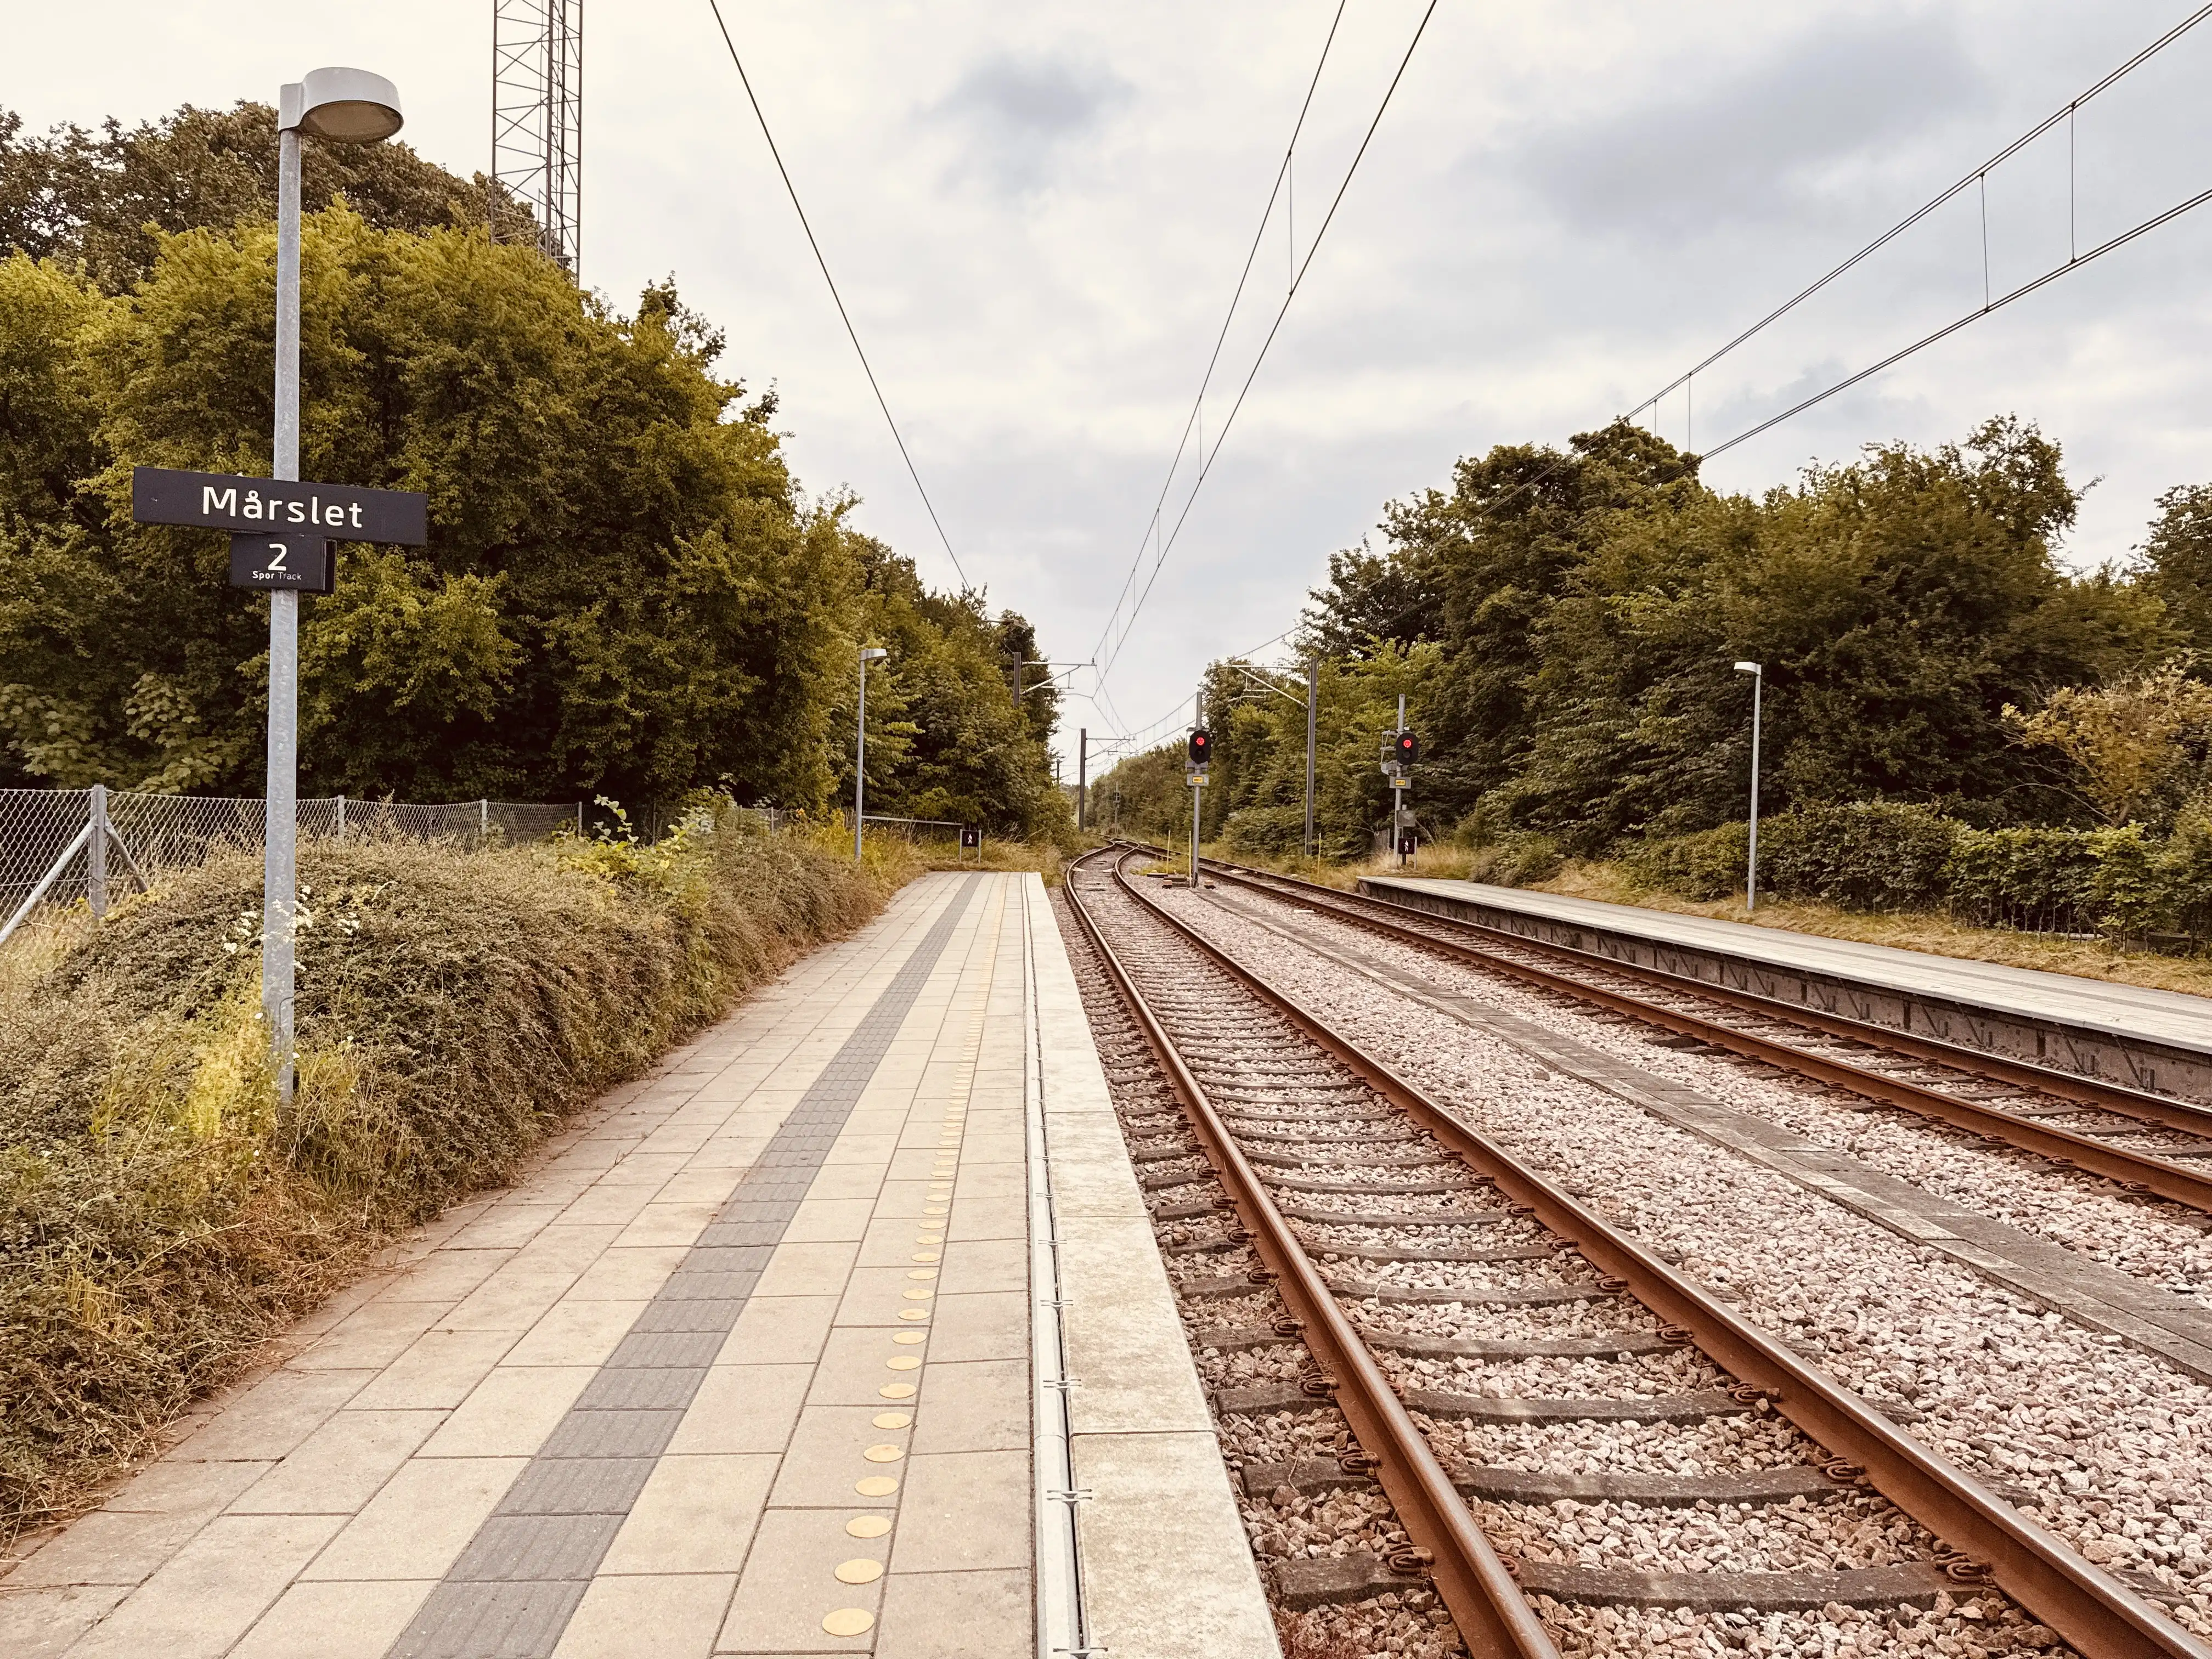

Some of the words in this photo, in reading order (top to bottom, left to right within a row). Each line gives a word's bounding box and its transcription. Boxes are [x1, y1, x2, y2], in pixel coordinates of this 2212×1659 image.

[202, 486, 363, 528] Mårslet
[268, 543, 287, 571] 2
[252, 571, 275, 581] Spor
[278, 571, 302, 580] Track
